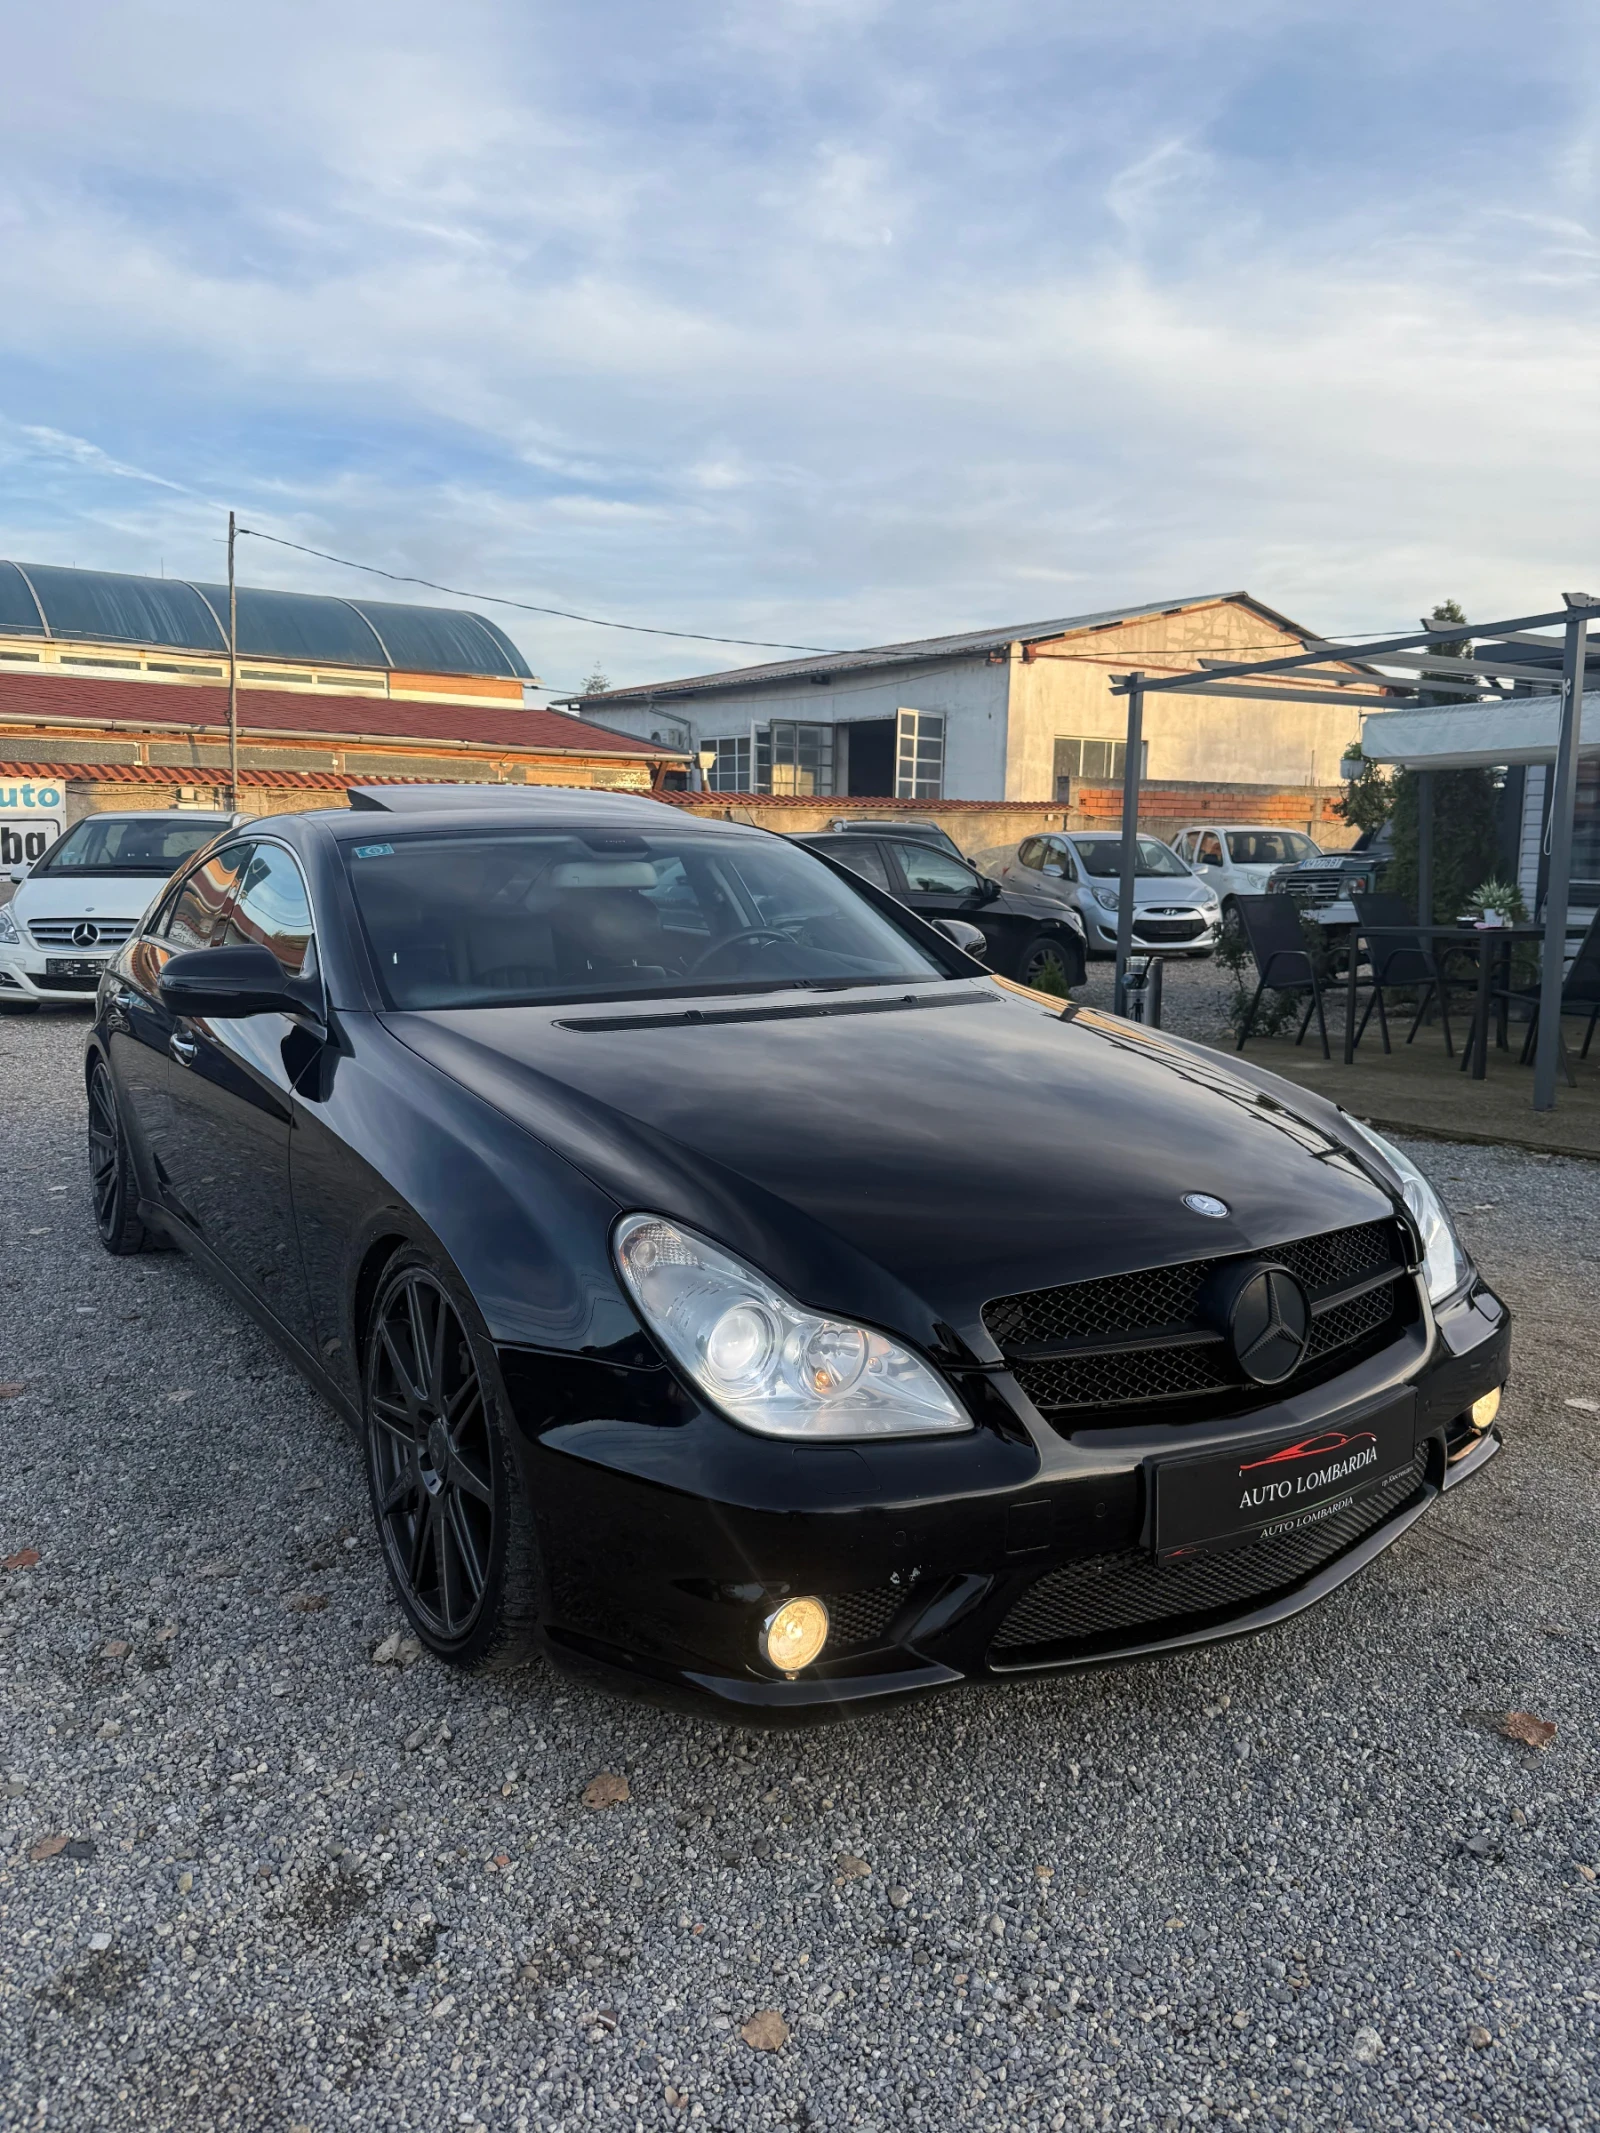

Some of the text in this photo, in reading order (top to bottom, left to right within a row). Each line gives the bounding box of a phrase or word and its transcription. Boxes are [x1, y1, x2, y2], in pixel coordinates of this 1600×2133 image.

[1239, 1445, 1377, 1508] AUTO LOMBARDIA
[1260, 1496, 1354, 1538] AUTO LOMBARDIA
